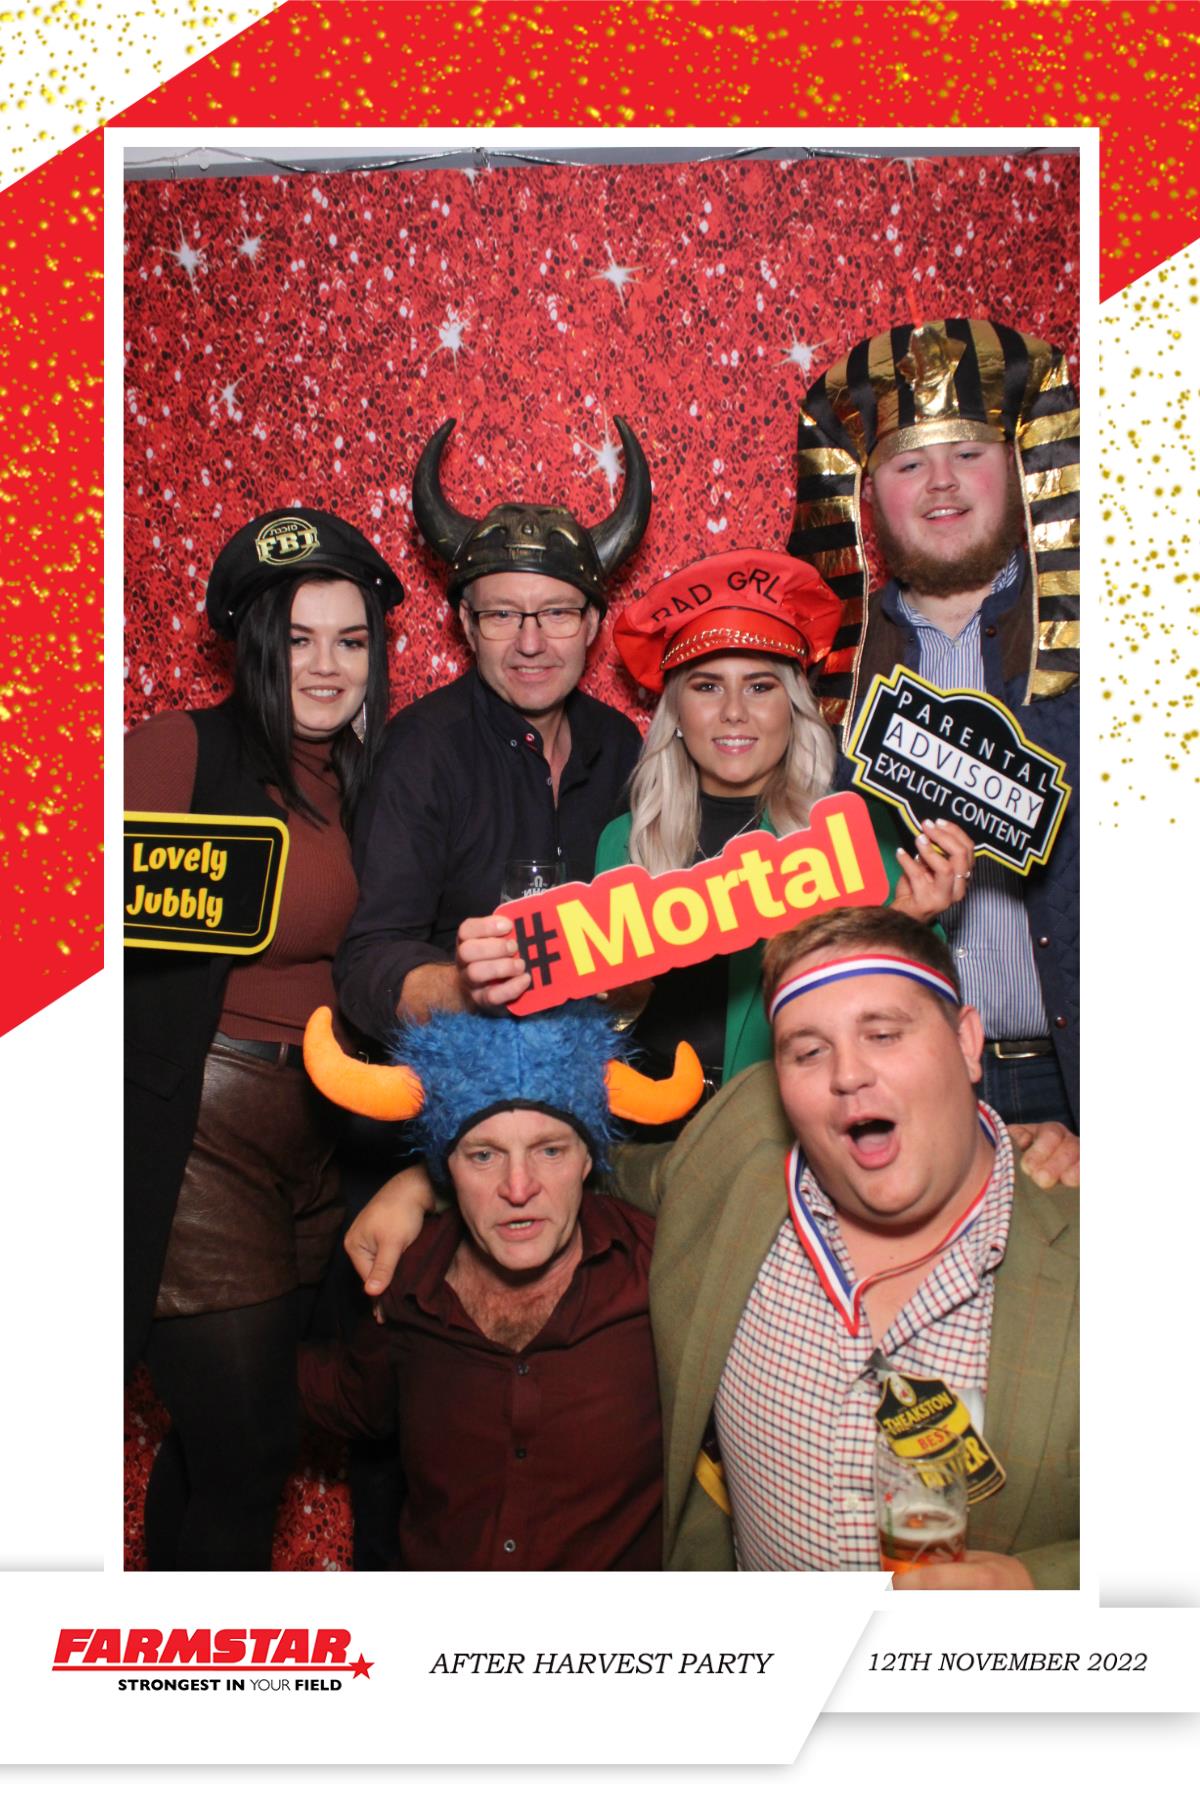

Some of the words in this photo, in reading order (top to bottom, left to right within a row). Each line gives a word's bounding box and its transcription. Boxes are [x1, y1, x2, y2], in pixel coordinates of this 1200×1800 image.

[256, 527, 320, 561] FBI
[727, 568, 781, 604] GRL
[897, 690, 1048, 793] PARENTAL
[885, 721, 1043, 821] ADVISORY
[874, 752, 953, 807] EXPLICIT
[951, 796, 1032, 851] CONTENT
[132, 841, 228, 881] Lovely
[126, 884, 224, 929] Jubbly
[513, 811, 866, 990] #Mortal
[882, 1391, 953, 1436] THEAKSTON
[916, 1424, 950, 1451] BEST
